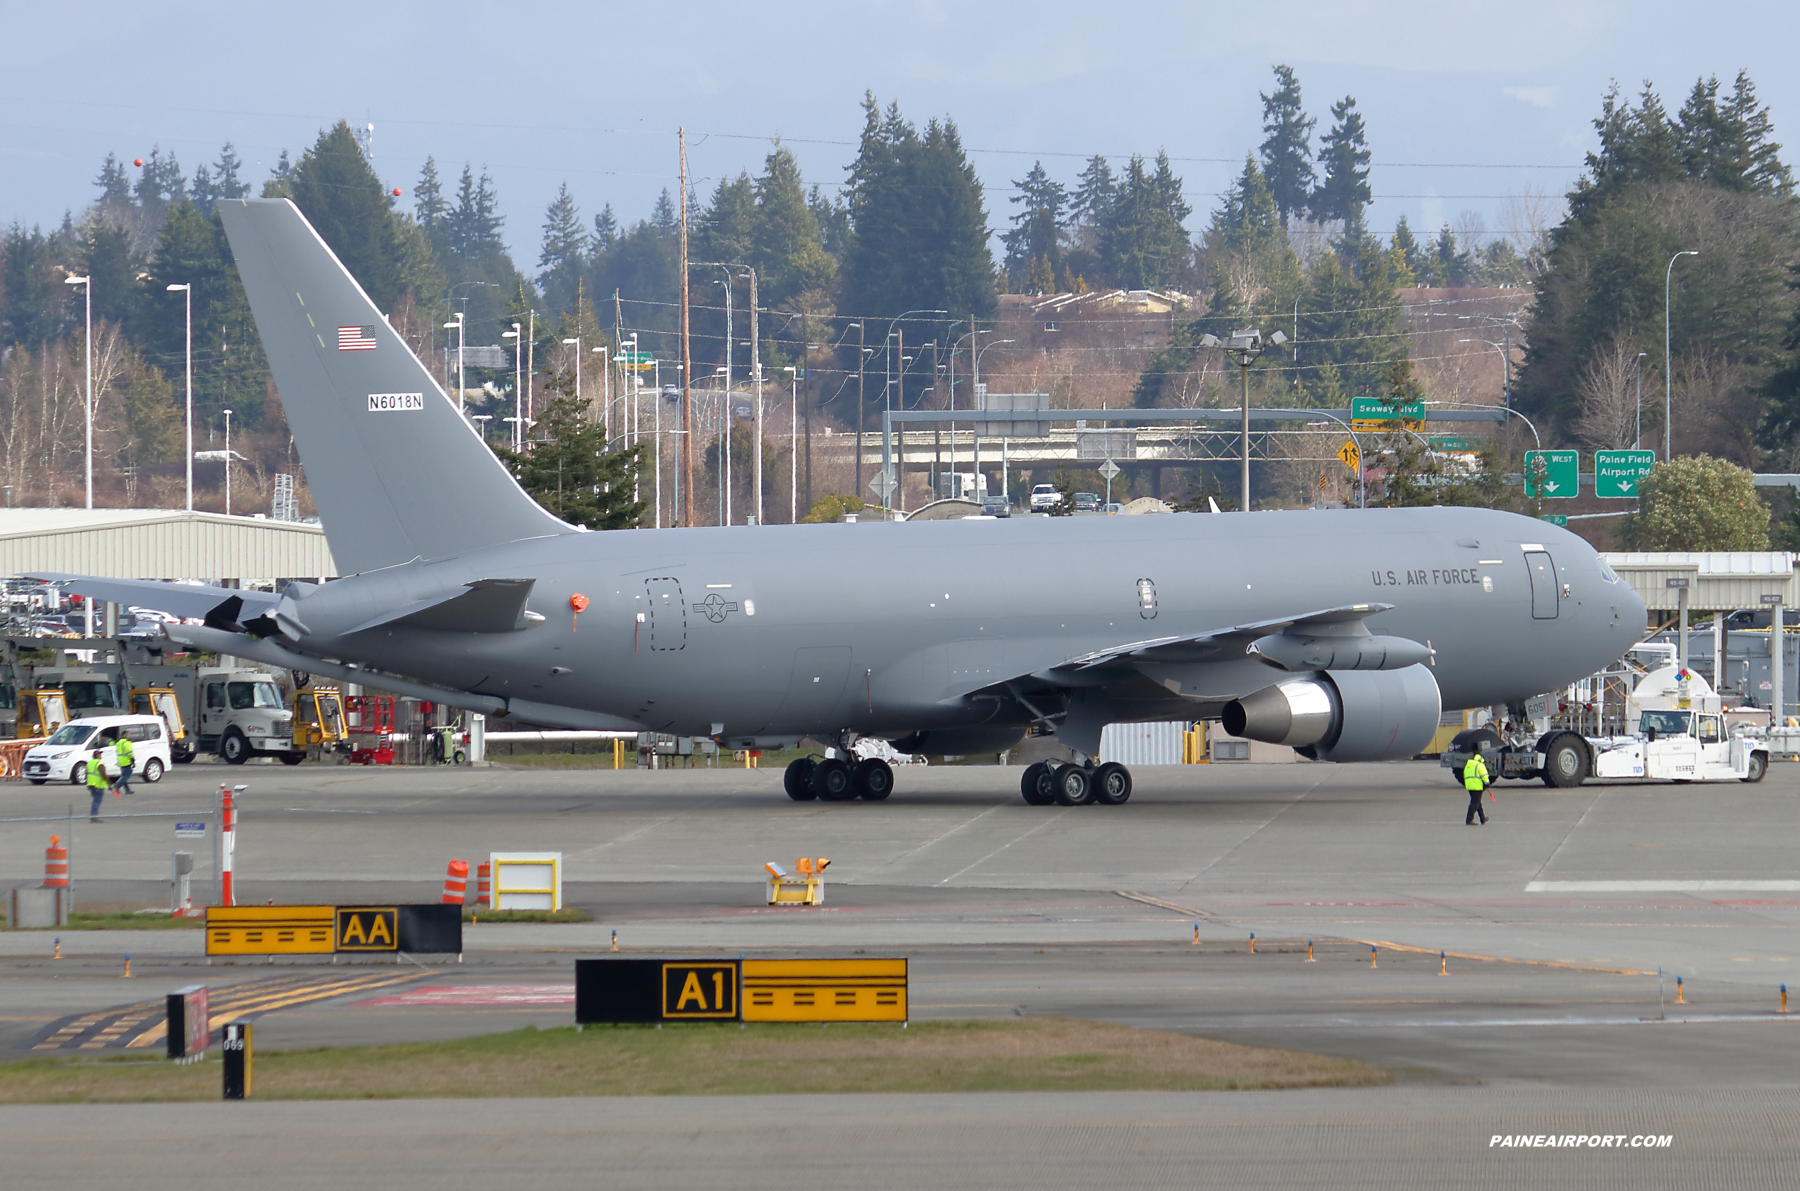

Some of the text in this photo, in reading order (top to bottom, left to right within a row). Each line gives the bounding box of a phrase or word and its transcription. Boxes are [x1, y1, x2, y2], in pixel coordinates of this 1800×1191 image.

[370, 395, 422, 409] N6018N
[1360, 405, 1393, 414] Seaway
[1552, 455, 1573, 463] WEST
[1600, 455, 1651, 464] Paine Field
[1601, 468, 1650, 478] Airport Rd
[1372, 569, 1480, 586] U.S. AIR FORCE
[1528, 702, 1546, 715] 6051
[1633, 766, 1643, 774] TLD
[342, 914, 391, 944] AA
[676, 971, 724, 1010] A1
[223, 1040, 244, 1051] 069
